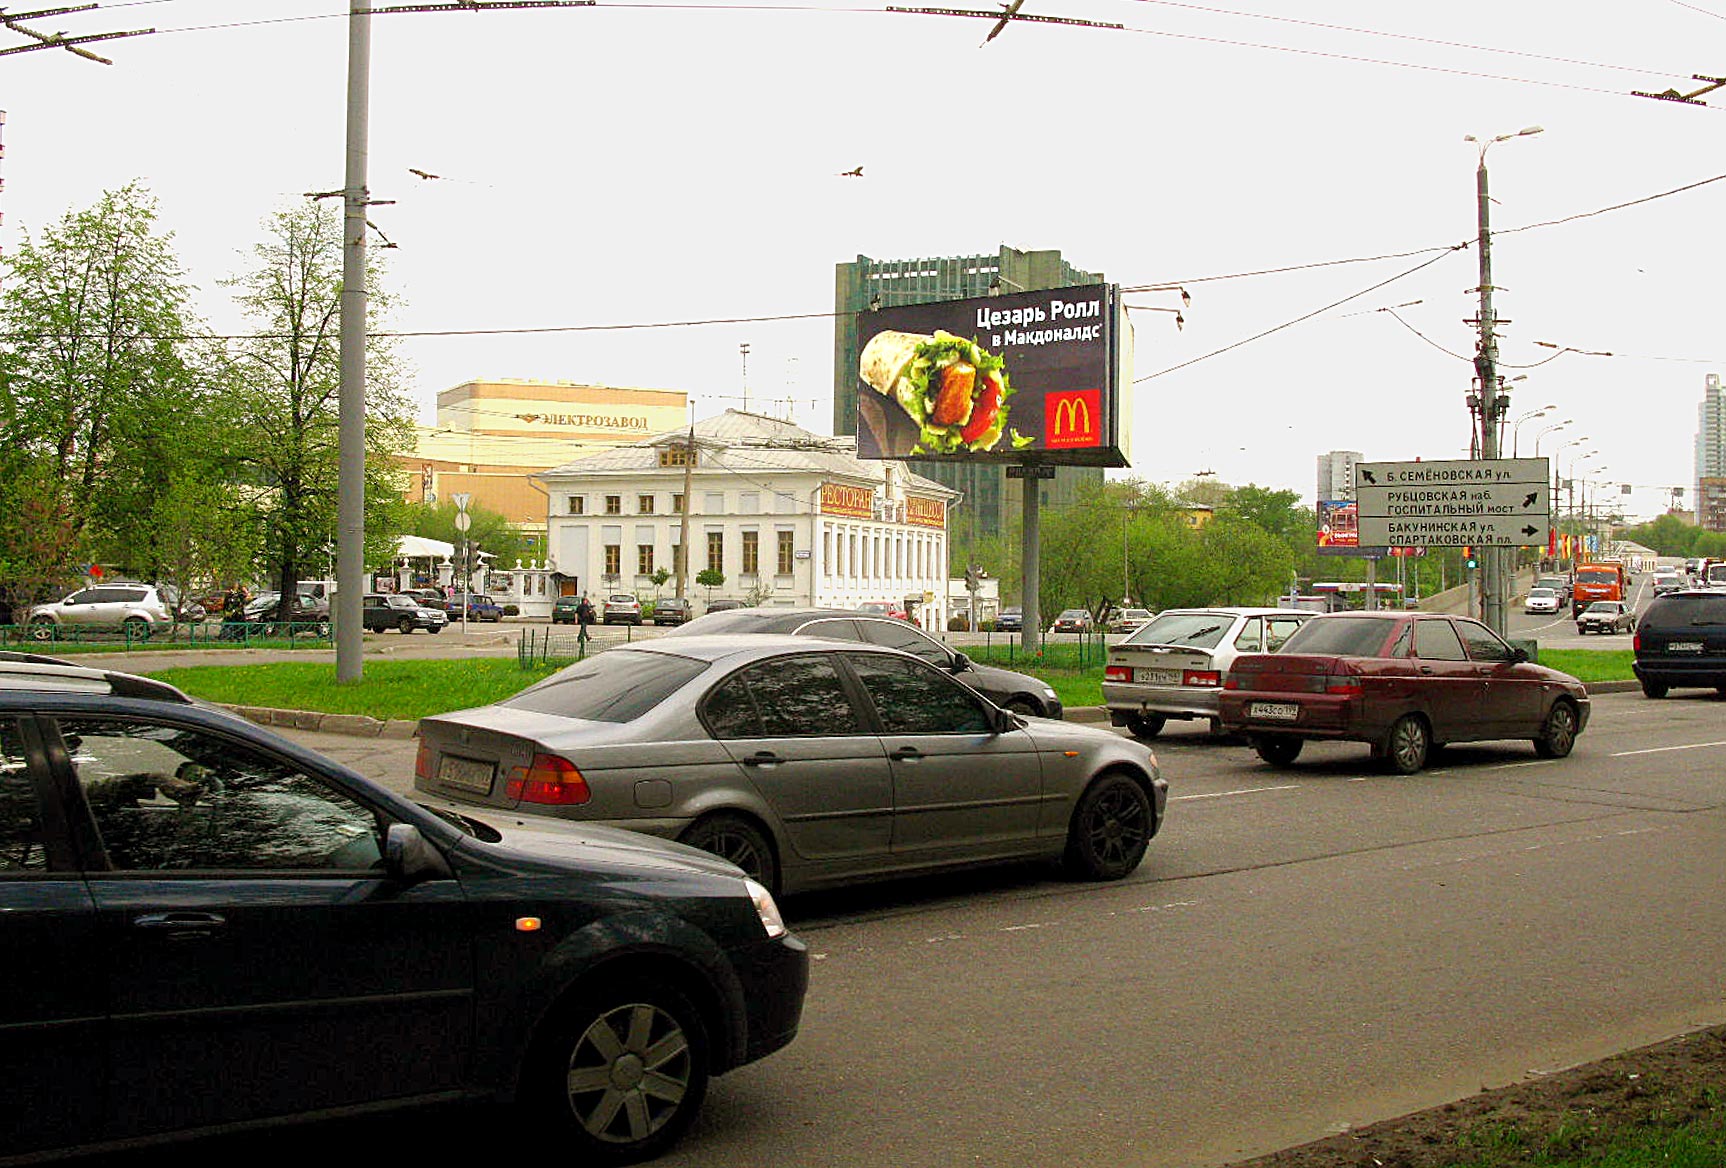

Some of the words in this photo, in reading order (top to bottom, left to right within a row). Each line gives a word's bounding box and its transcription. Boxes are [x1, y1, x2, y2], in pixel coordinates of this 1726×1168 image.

[976, 306, 1046, 330] Цезарь
[1050, 299, 1100, 321] Ролл
[991, 334, 1001, 347] в
[540, 413, 648, 430] ЭЛЕКТРОЗАВОД
[1399, 468, 1492, 481] СЕМЁНОВСКАЯ
[821, 484, 872, 509] РЕСТОРАН
[1387, 490, 1467, 503] РУБЦОВСКАЯ
[1387, 501, 1484, 515] ГОСПИТАЛЬНЫЙ
[1487, 505, 1514, 513] мост
[1388, 521, 1476, 533] БАКУНИНСКАЯ
[1389, 534, 1493, 545] СПАРТАКОВСКАЯ
